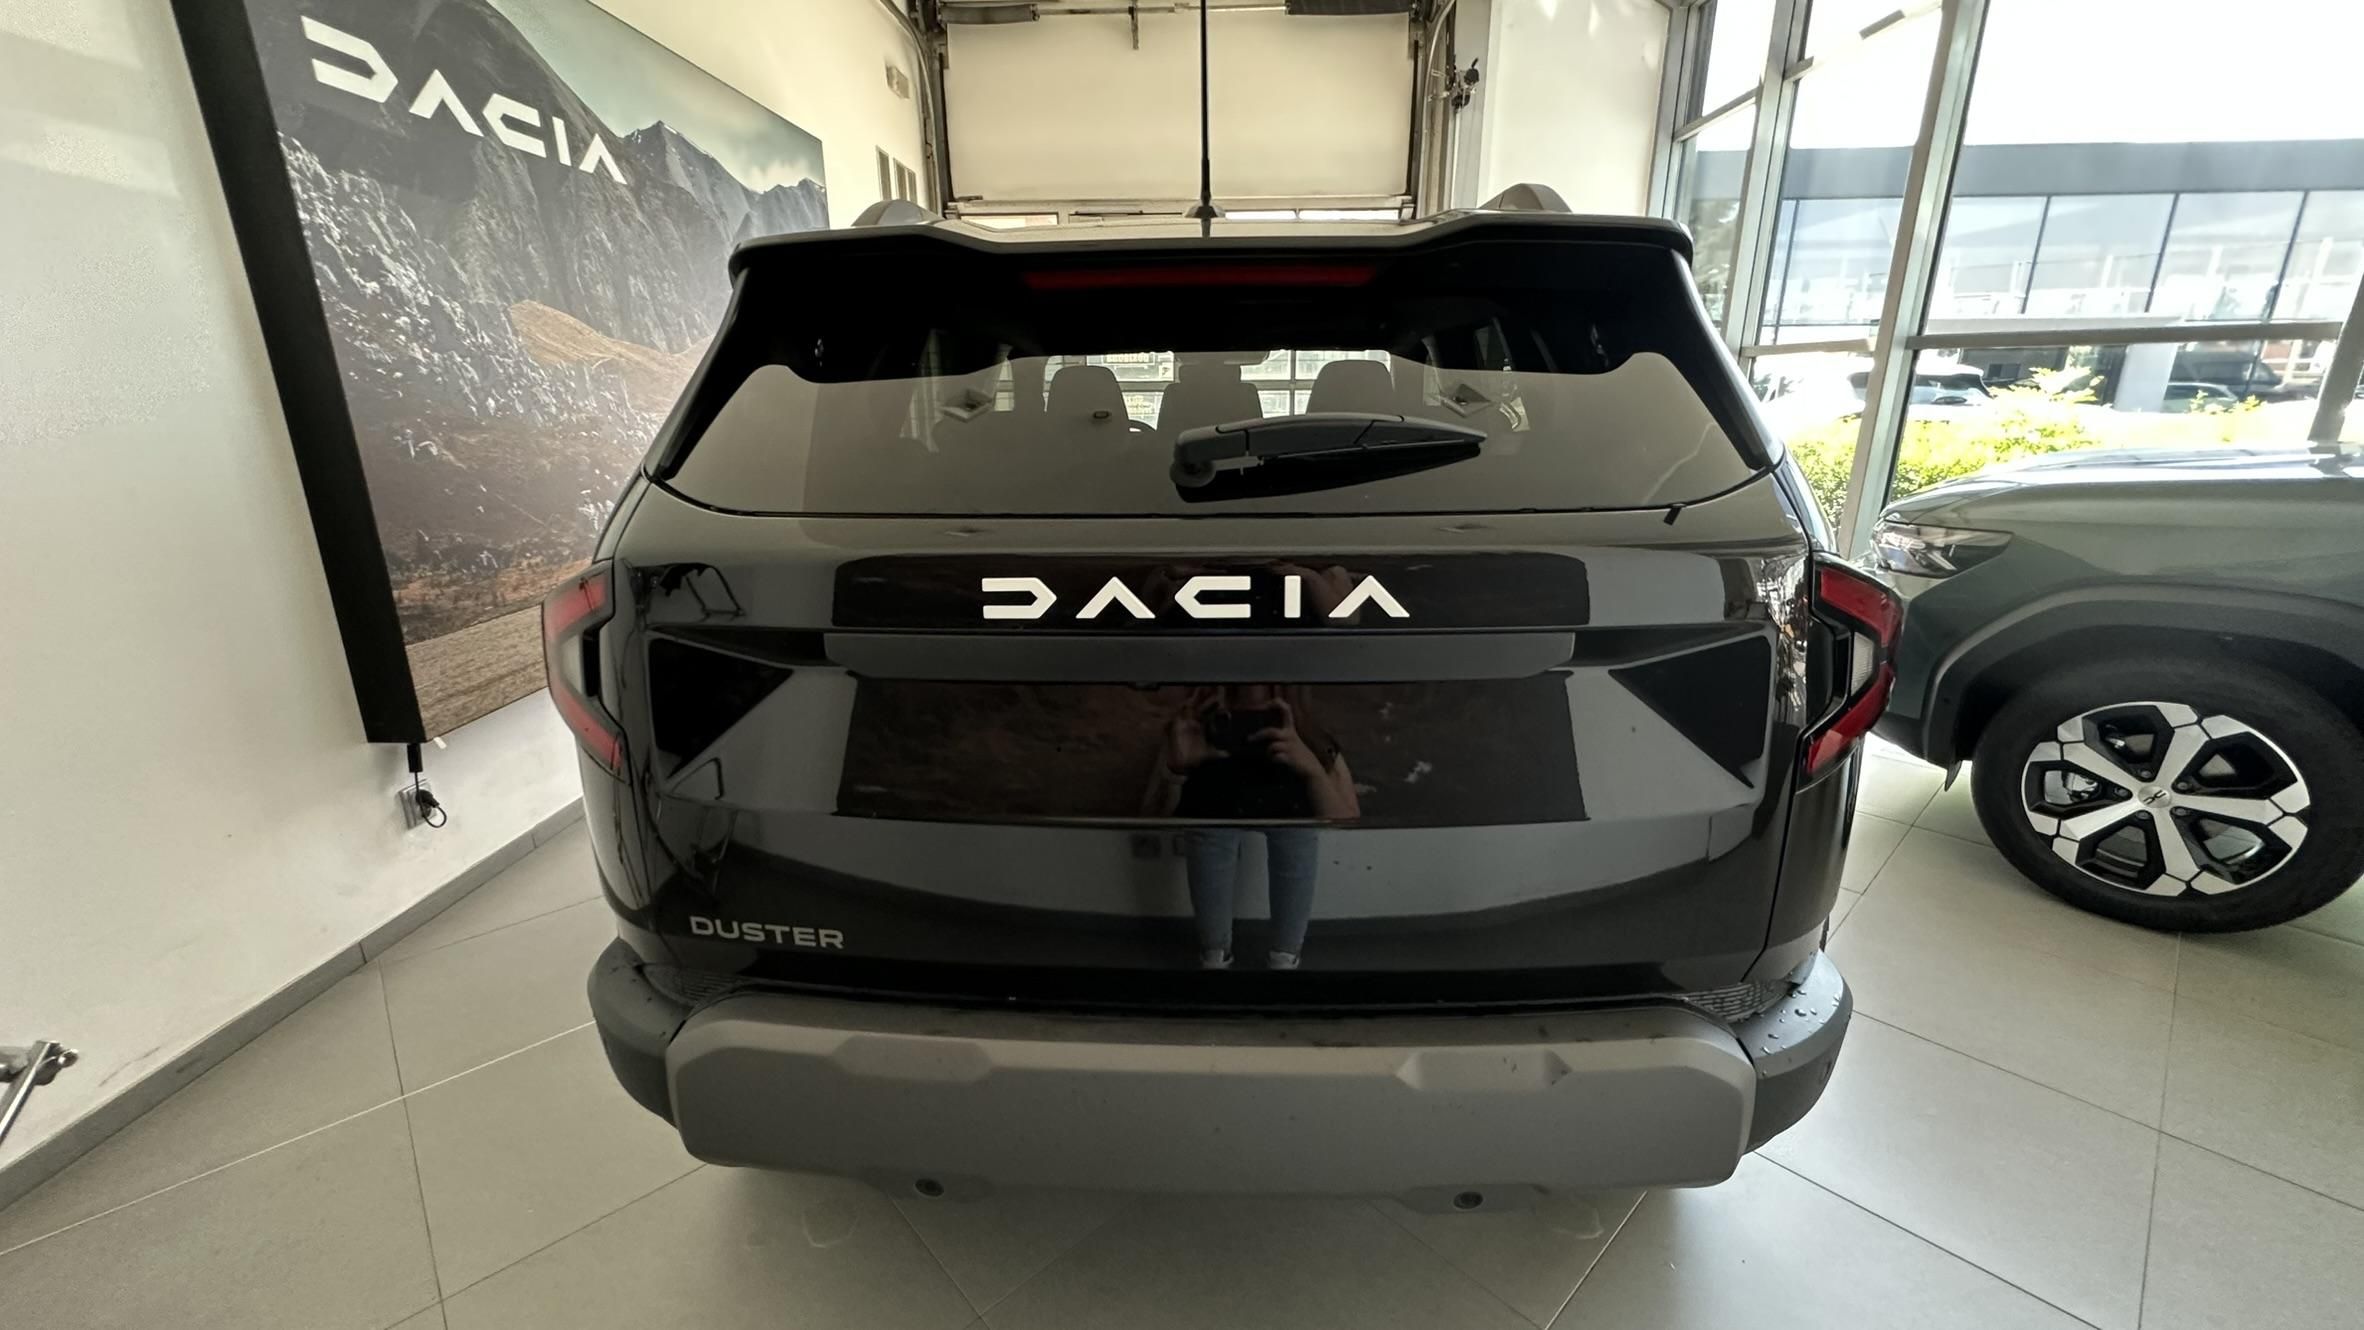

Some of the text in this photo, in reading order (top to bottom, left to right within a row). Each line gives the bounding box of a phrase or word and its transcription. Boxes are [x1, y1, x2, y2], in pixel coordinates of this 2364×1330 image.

[301, 15, 627, 185] DACIA
[982, 575, 1410, 619] DACIA
[689, 916, 844, 949] DUSTER
